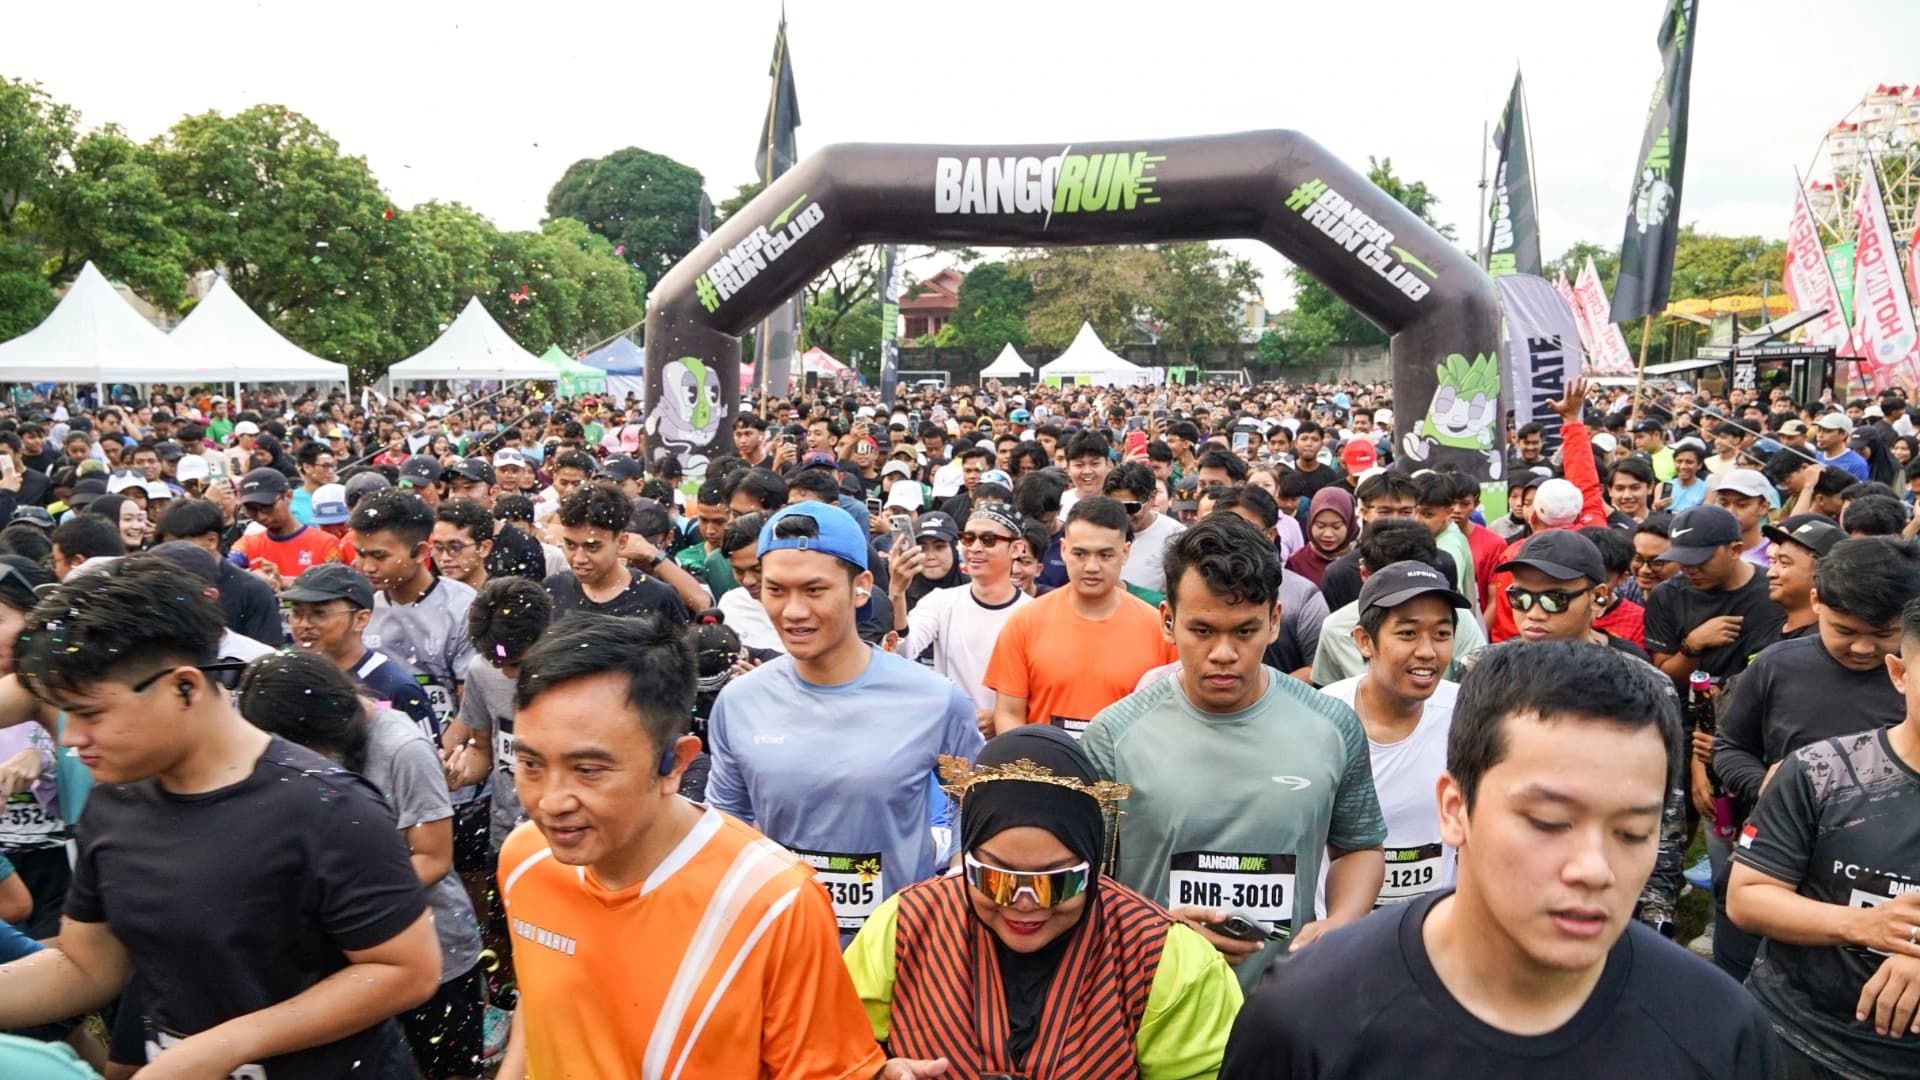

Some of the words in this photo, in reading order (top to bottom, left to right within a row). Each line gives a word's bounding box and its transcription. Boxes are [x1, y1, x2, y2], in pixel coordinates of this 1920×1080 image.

[714, 251, 768, 302] RUN
[763, 202, 825, 262] CLUB
[1301, 202, 1366, 252] RUN
[1356, 243, 1431, 302] CLUB
[1180, 879, 1284, 908] BNR-3010
[1198, 854, 1240, 870] BANGOR
[1239, 856, 1263, 871] RUN
